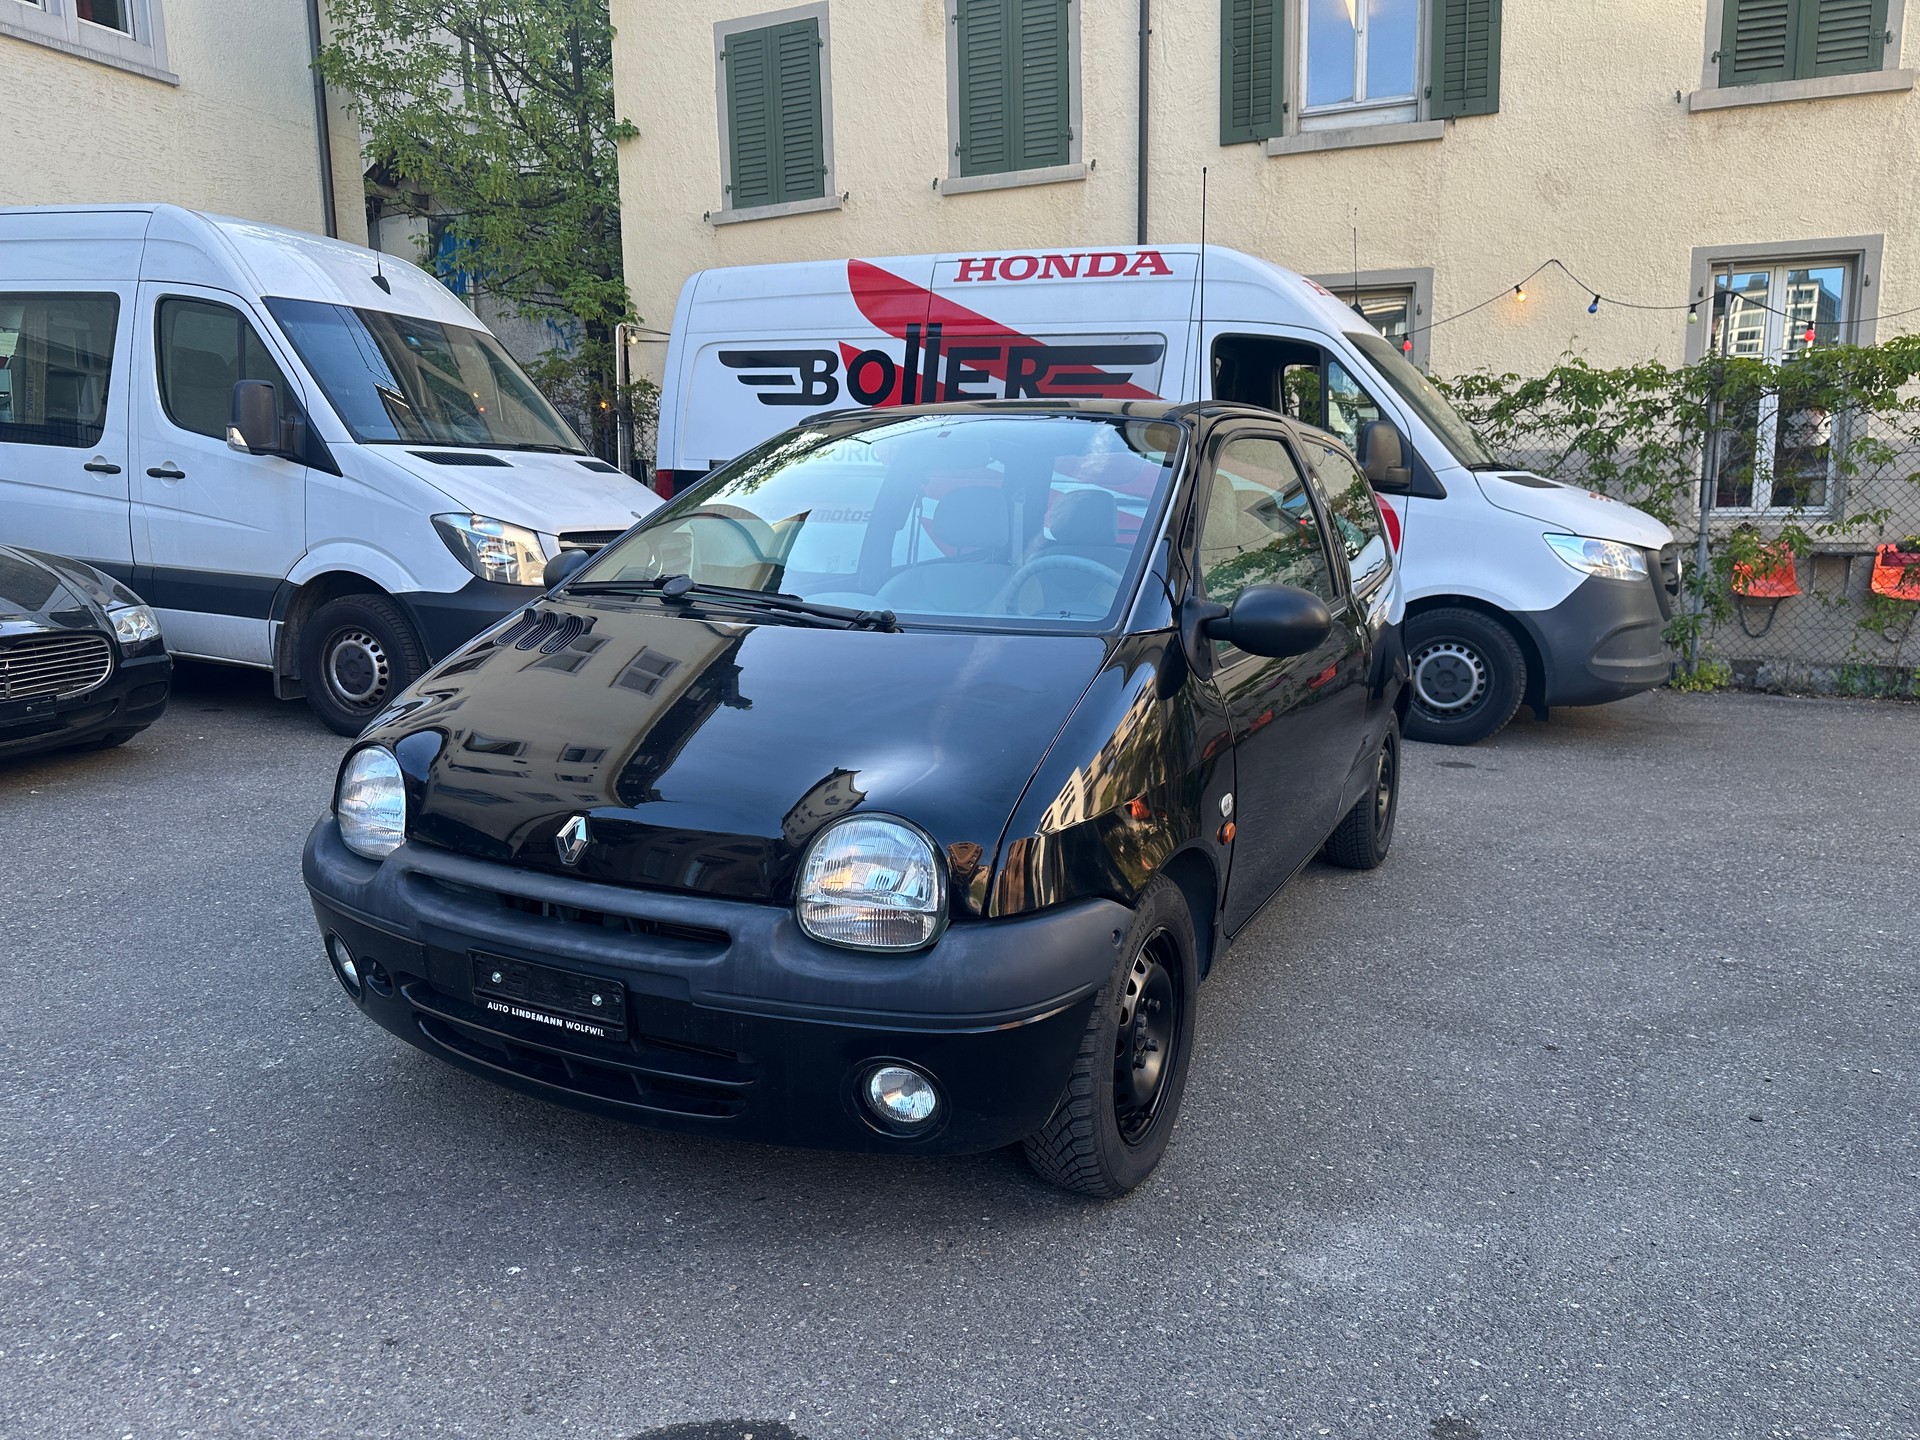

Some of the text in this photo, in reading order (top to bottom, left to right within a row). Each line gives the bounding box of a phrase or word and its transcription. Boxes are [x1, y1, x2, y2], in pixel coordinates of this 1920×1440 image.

[954, 250, 1173, 282] HONDA
[487, 1001, 605, 1037] AUTO LINDEMANN WOLFWIL
